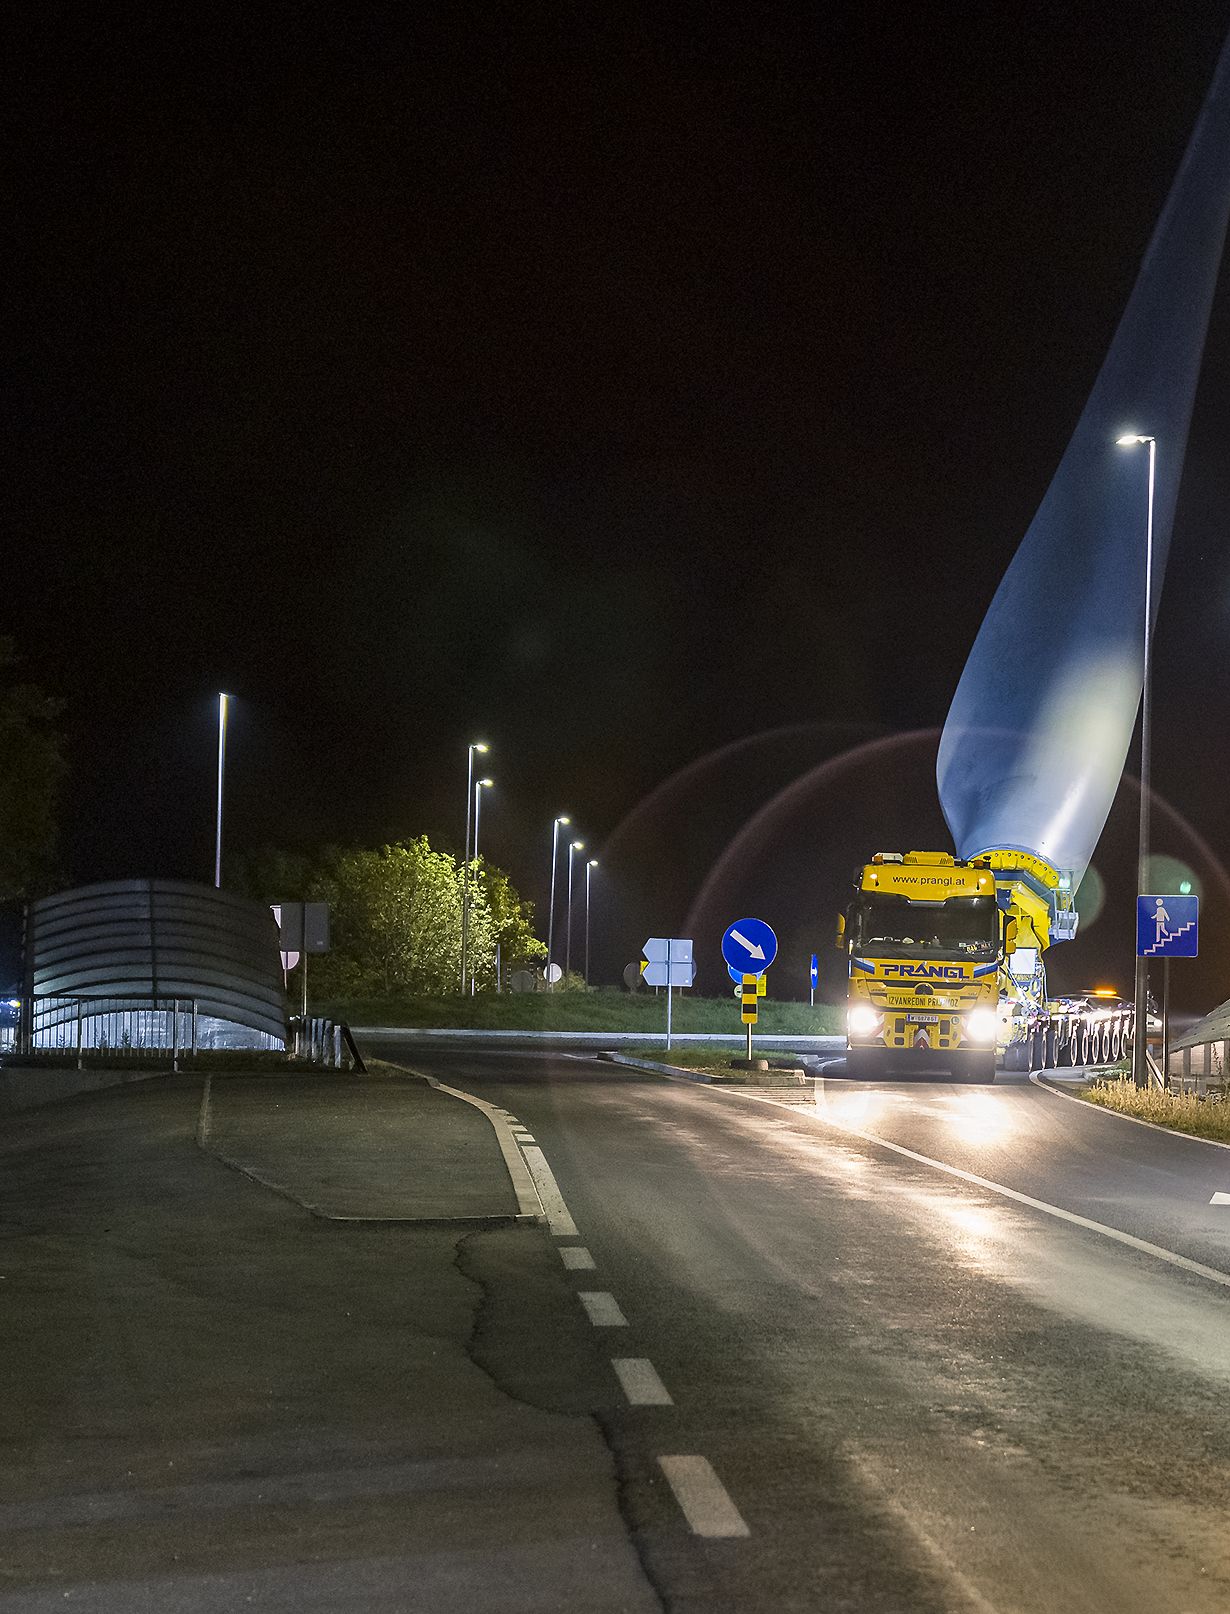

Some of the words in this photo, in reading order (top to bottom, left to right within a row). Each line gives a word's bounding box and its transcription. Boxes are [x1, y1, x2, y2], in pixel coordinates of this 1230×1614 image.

[892, 876, 965, 887] www.prangl.at
[880, 962, 970, 979] PRANGL
[888, 996, 926, 1006] IZVANREDNI
